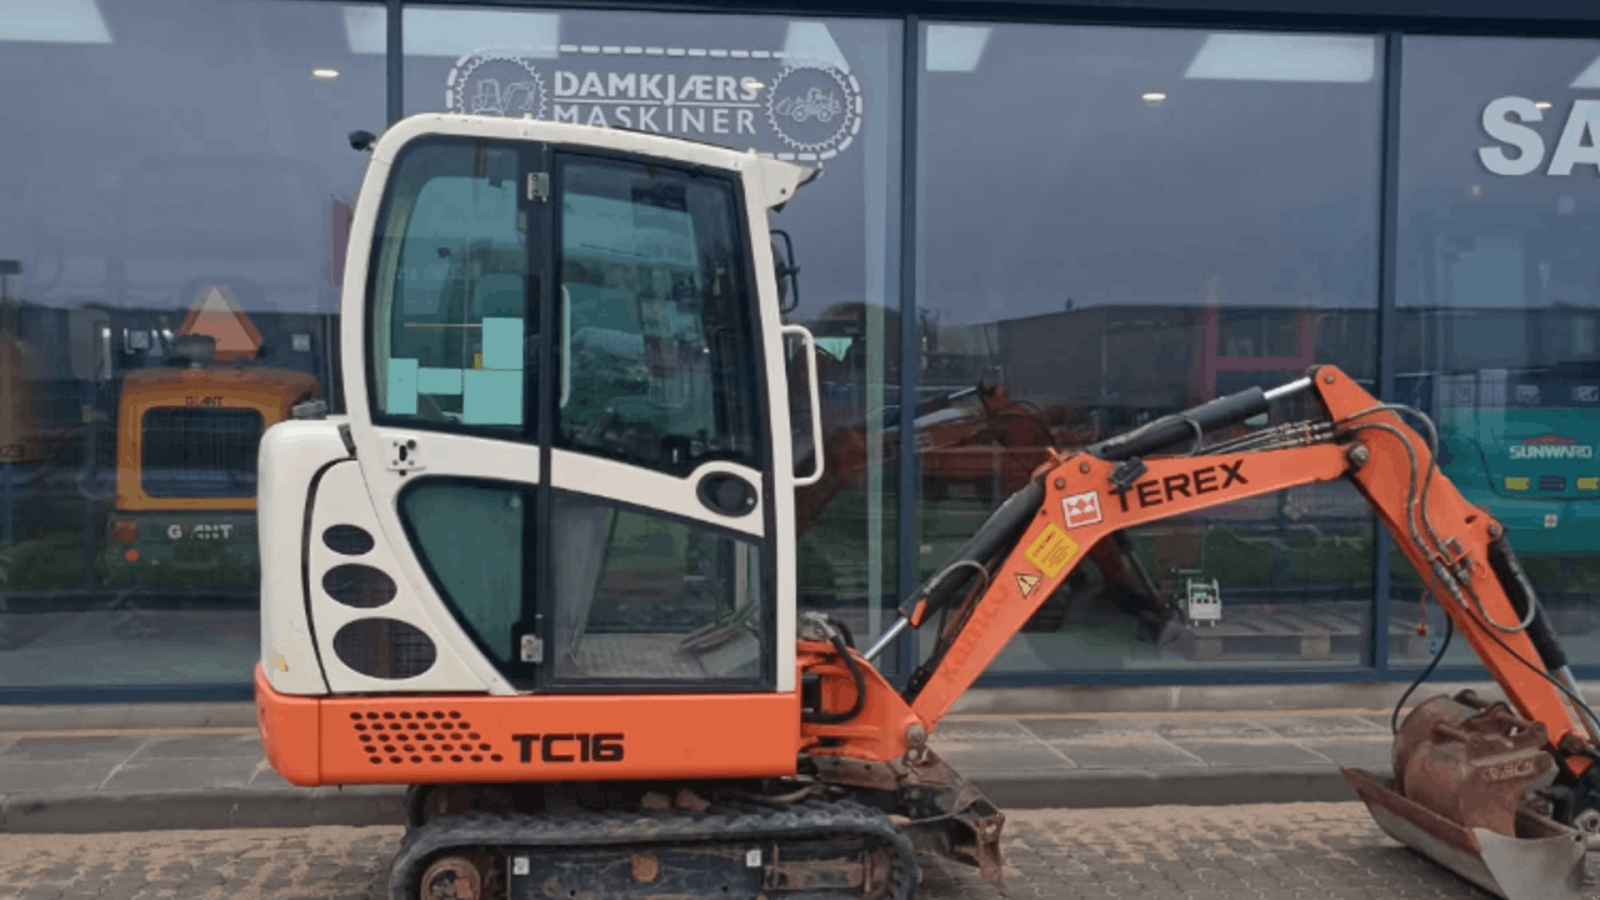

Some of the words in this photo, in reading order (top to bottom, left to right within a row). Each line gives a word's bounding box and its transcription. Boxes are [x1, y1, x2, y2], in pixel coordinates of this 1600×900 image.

[554, 70, 758, 106] DAMKJÆRS
[554, 105, 757, 136] MASKINER
[1479, 95, 1600, 176] SA
[1509, 445, 1593, 459] SUNWARD
[1108, 459, 1249, 513] TEREX
[511, 732, 625, 764] TC16
